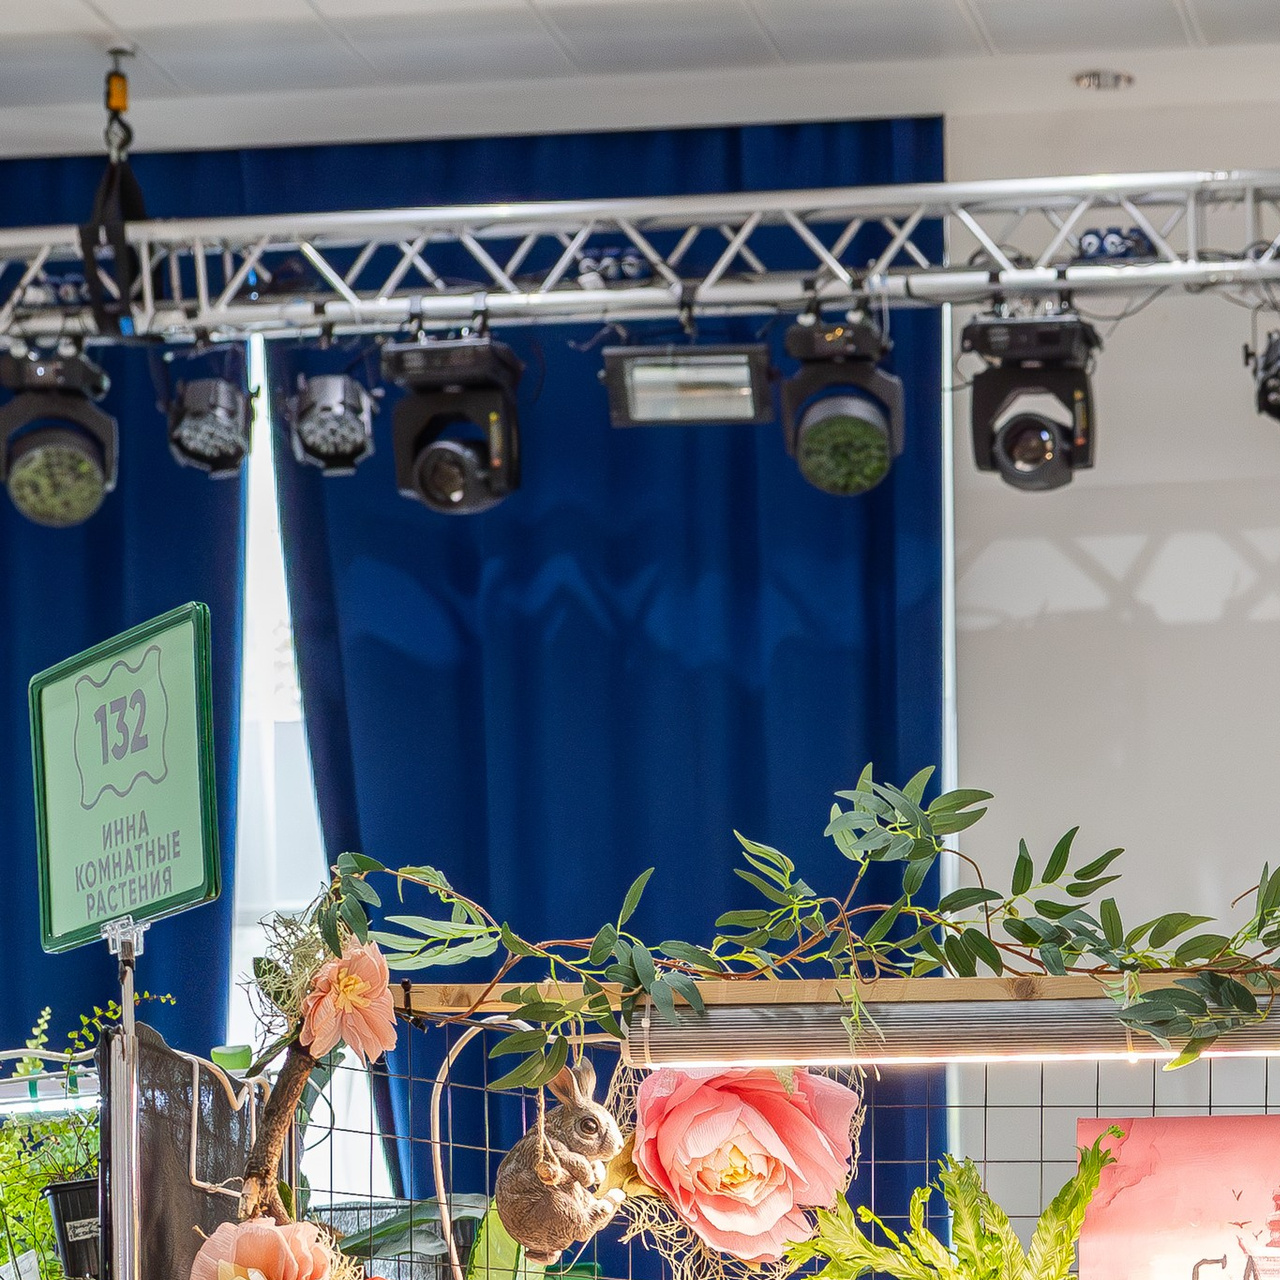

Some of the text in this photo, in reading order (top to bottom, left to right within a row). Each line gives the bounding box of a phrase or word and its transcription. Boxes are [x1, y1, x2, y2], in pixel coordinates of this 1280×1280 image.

[93, 688, 149, 766] 132
[101, 809, 150, 852] ИННА
[75, 830, 181, 893] КОМНАТНЫЕ
[86, 865, 173, 920] РАСТЕНИЯ
